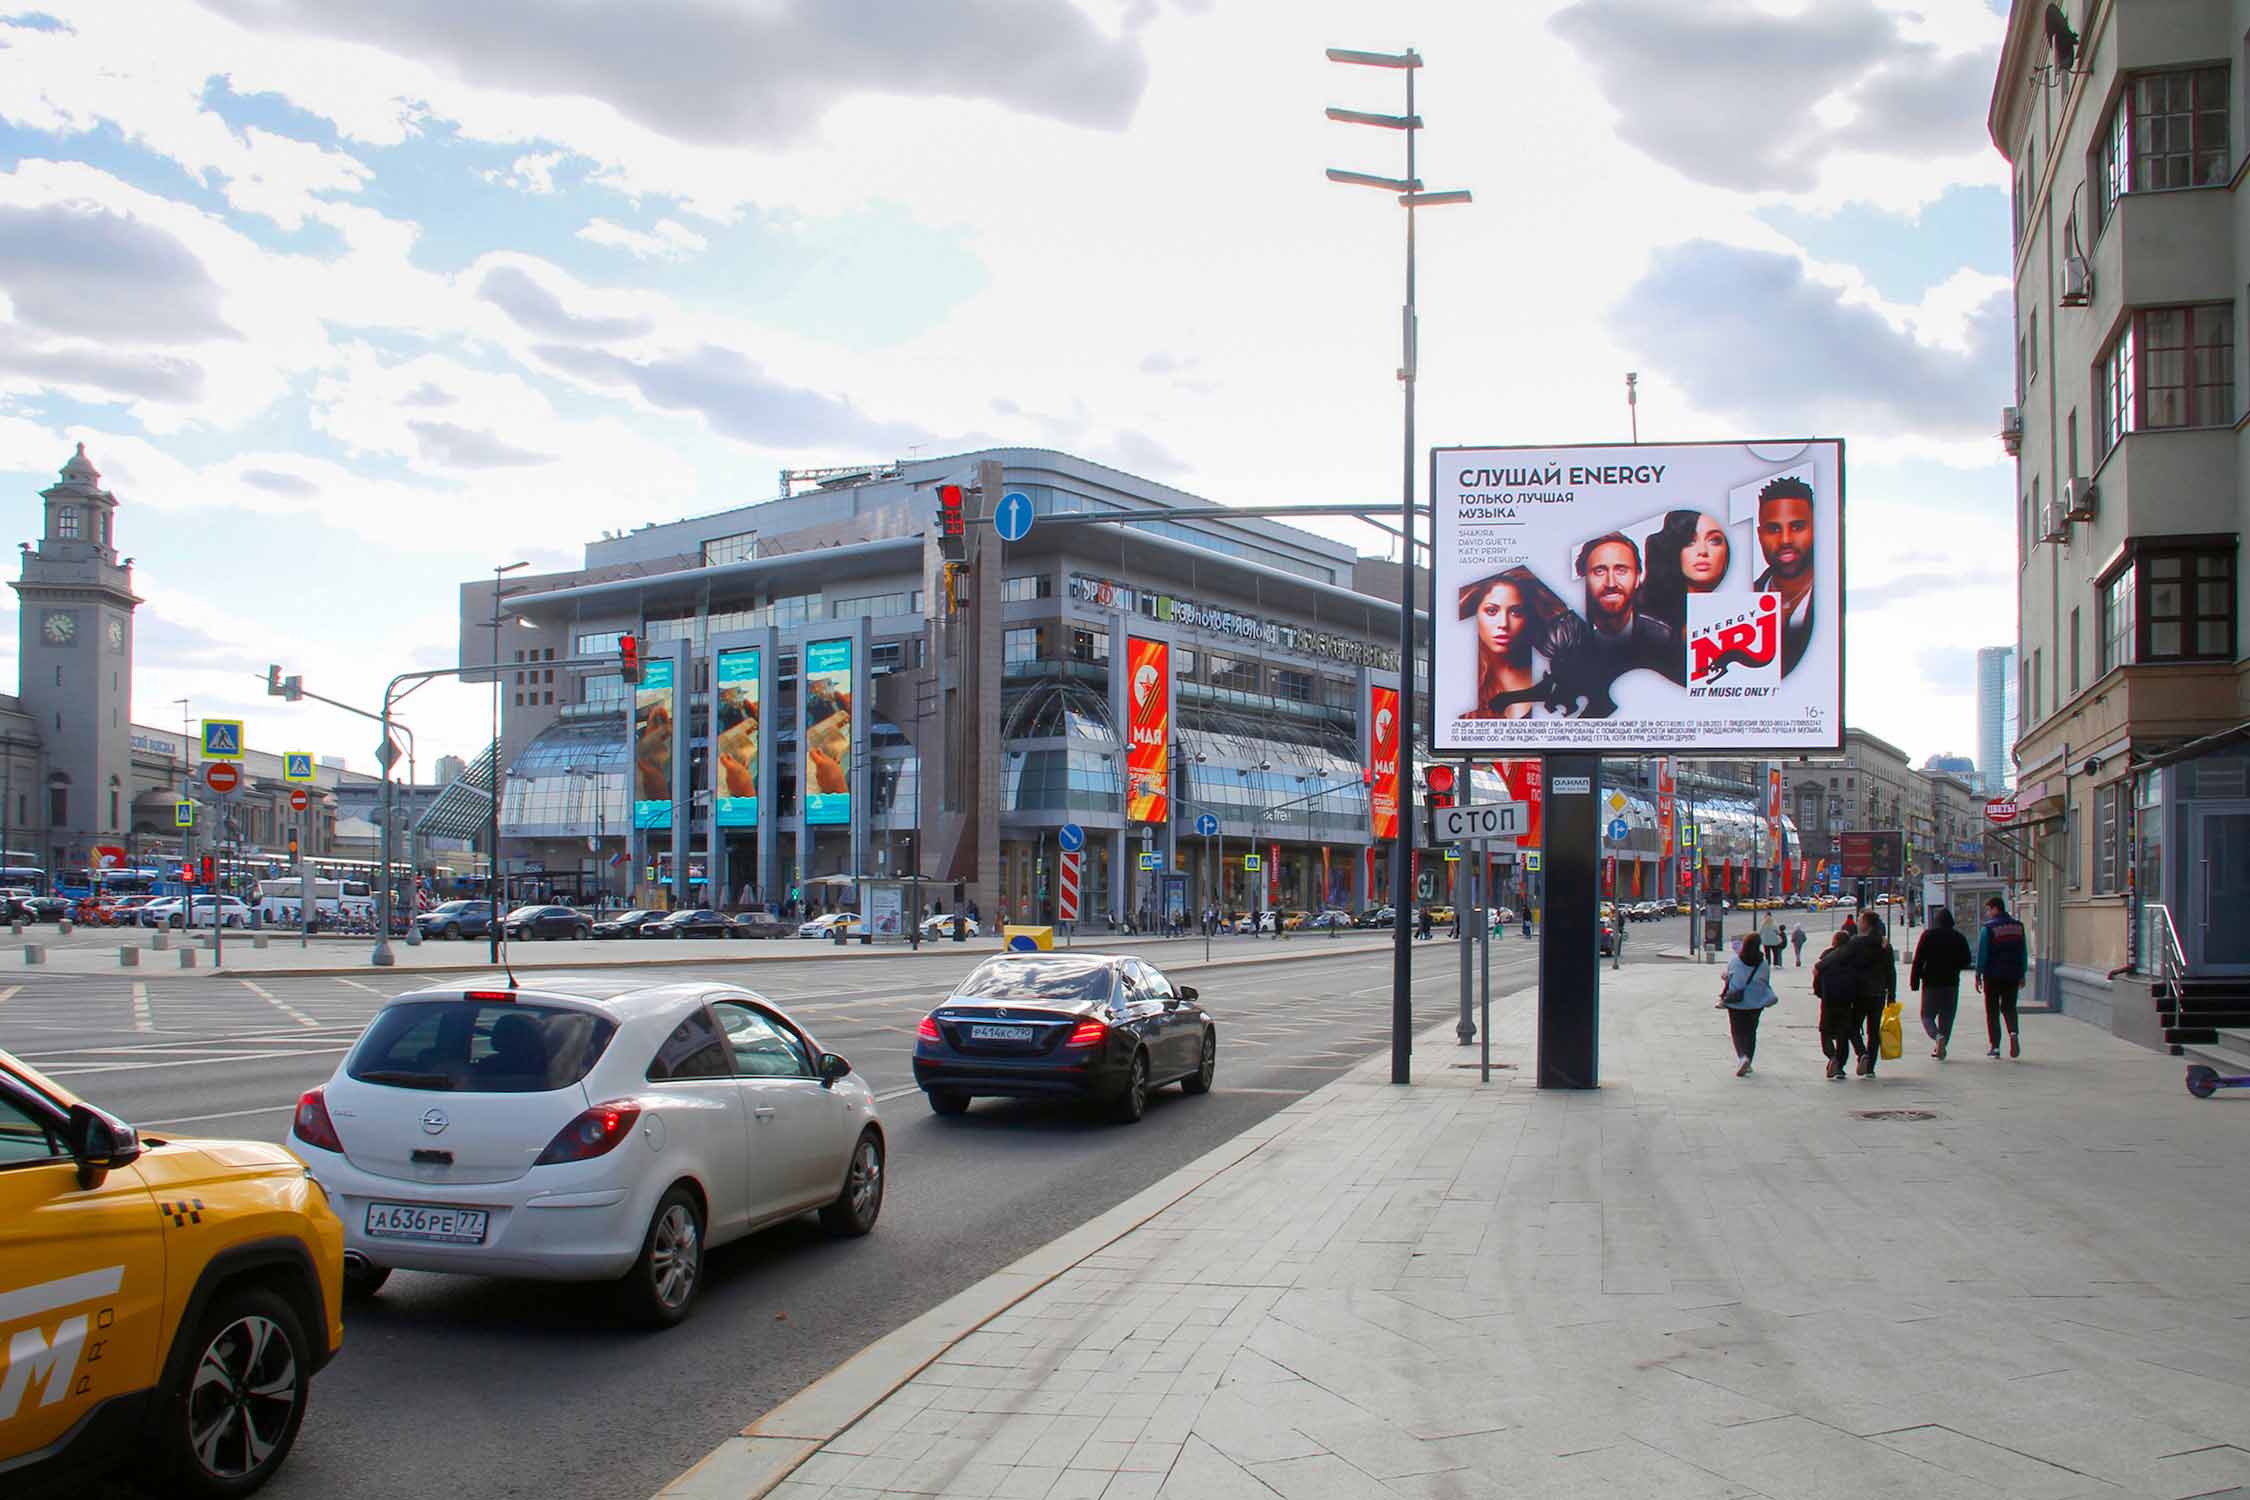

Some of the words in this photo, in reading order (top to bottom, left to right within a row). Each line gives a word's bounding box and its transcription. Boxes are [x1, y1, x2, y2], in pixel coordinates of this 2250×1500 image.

[1459, 462, 1561, 487] СЛУШАЙ
[1569, 465, 1666, 486] ENERGY
[1459, 493, 1513, 505] ТОЛЬКО
[1516, 492, 1574, 504] ЛУЧШАЯ
[1692, 610, 1756, 639] ENERGY
[1689, 688, 1706, 697] HIT
[1708, 688, 1742, 697] MUSIC
[1744, 688, 1769, 697] ONLY
[1805, 706, 1824, 718] 16+
[1134, 726, 1162, 745] МАЯ
[1375, 759, 1395, 775] МАЯ
[1448, 808, 1515, 834] СТОП
